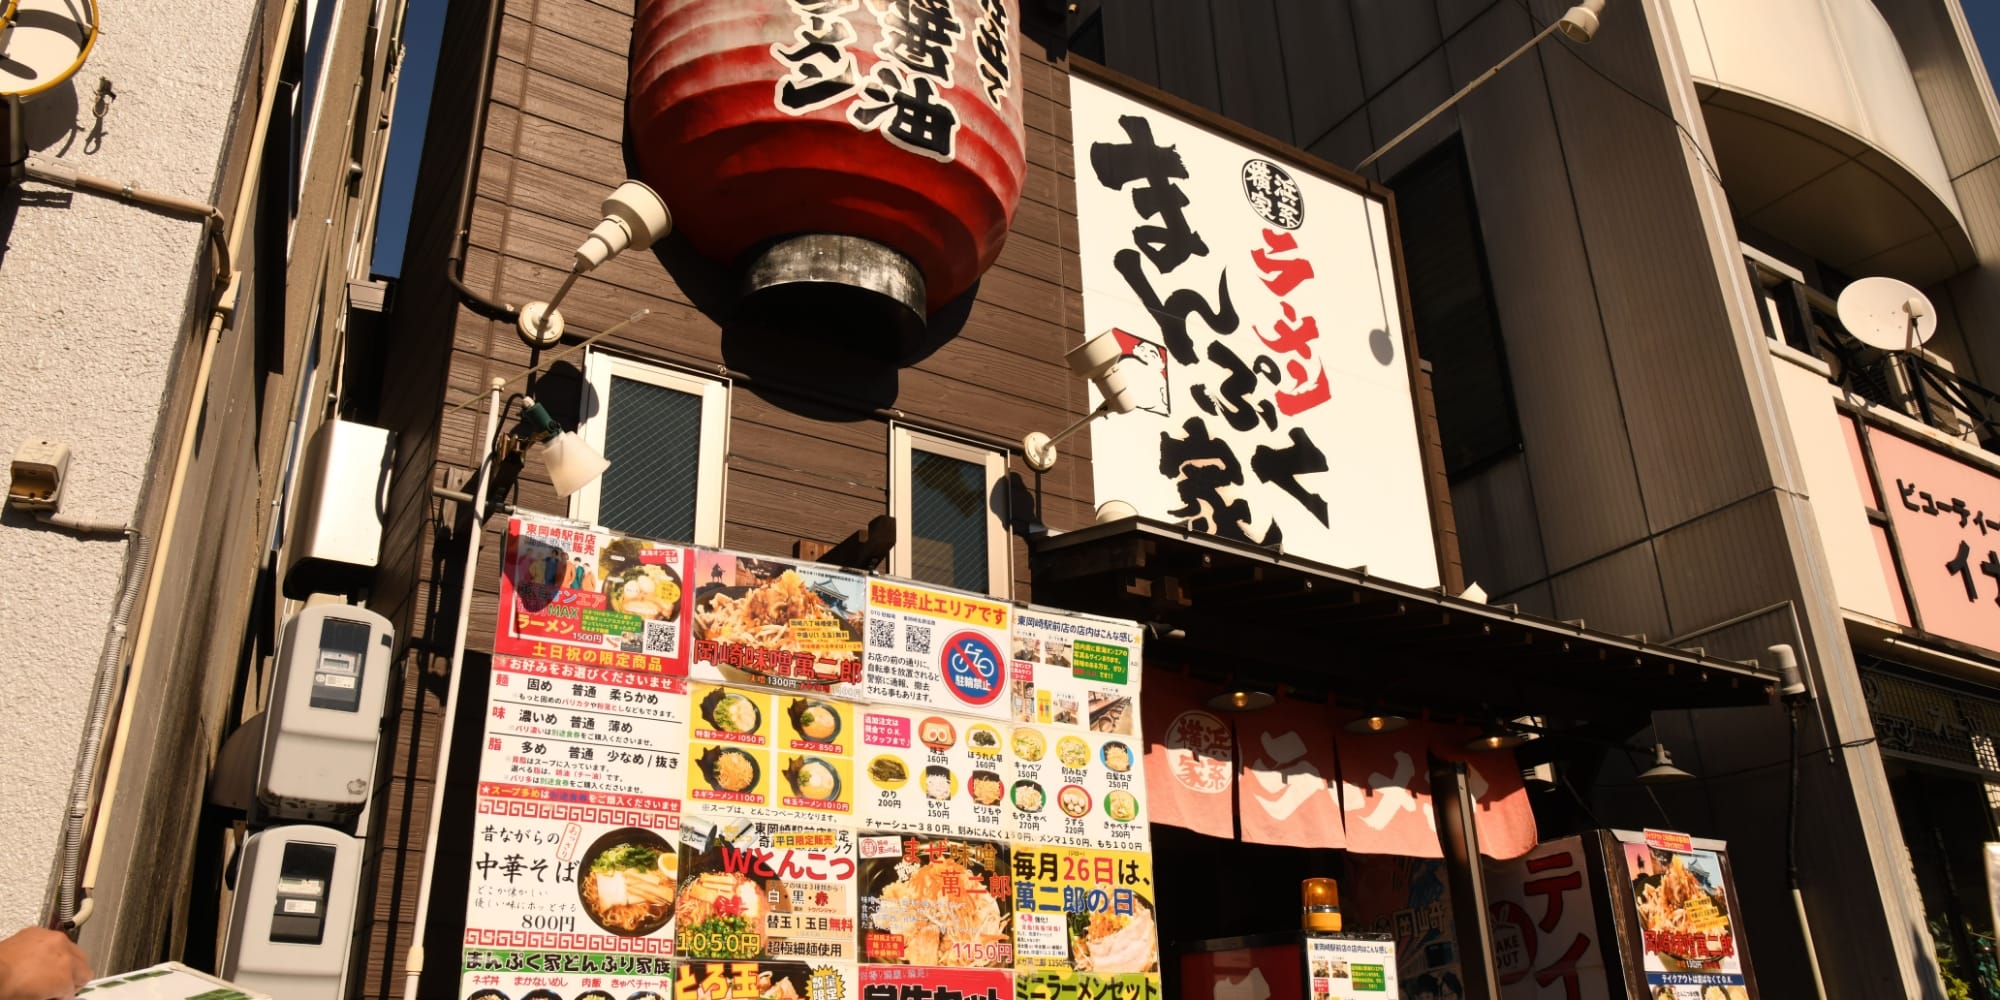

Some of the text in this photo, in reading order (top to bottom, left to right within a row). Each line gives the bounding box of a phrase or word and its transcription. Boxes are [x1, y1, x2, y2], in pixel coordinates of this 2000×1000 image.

[777, 0, 859, 110] ーメン
[1250, 228, 1332, 416] ラーメン
[526, 522, 596, 546] 東岡崎駅前店
[871, 584, 1007, 626] 駐輪禁止エリアです
[518, 613, 575, 634] ラーメン
[1017, 615, 1134, 643] 東岡崎駅前店の店内はこんな感じ
[572, 631, 602, 643] 1500円
[532, 642, 662, 672] 土日祝の限定商品
[693, 638, 863, 686] 岡崎味噌萬二郎
[867, 652, 931, 670] お店の前の通りに、
[510, 659, 673, 689] お好みをお選びくださいませ
[767, 676, 797, 688] 1300円
[527, 678, 552, 692] 固め
[571, 684, 597, 698] 普通
[609, 688, 659, 705] 柔らかめ
[866, 685, 933, 704] される事もあります。
[492, 706, 633, 733] 味 濃いめ 普通 薄め
[488, 737, 502, 751] 脂
[521, 740, 547, 755] 多め
[568, 746, 594, 760] 普通
[790, 740, 816, 750] ラーメン
[1014, 761, 1042, 771] キャベツ
[878, 798, 901, 809] 200円
[881, 790, 897, 798] のり
[928, 800, 950, 809] もやし
[927, 809, 950, 819] 150円
[481, 824, 560, 846] 昔ながらの
[721, 847, 855, 880] Wとんこつ
[903, 836, 998, 872] まぜ味噌
[475, 851, 581, 884] 中華そば
[1013, 851, 1151, 886] 毎月26日は、
[941, 869, 1012, 903] 萬二郎
[1014, 880, 1134, 917] 萬二郎の日
[521, 914, 576, 933] 800円
[677, 932, 760, 955] 1050円
[767, 940, 842, 957] 超極細麺使用
[952, 942, 1013, 963] 1150円
[465, 950, 672, 975] まんぷく家どんぶり家族
[514, 977, 569, 988] まかないめし
[675, 963, 761, 999] とろ玉
[1016, 972, 1158, 1000] ミニラーメンセット
